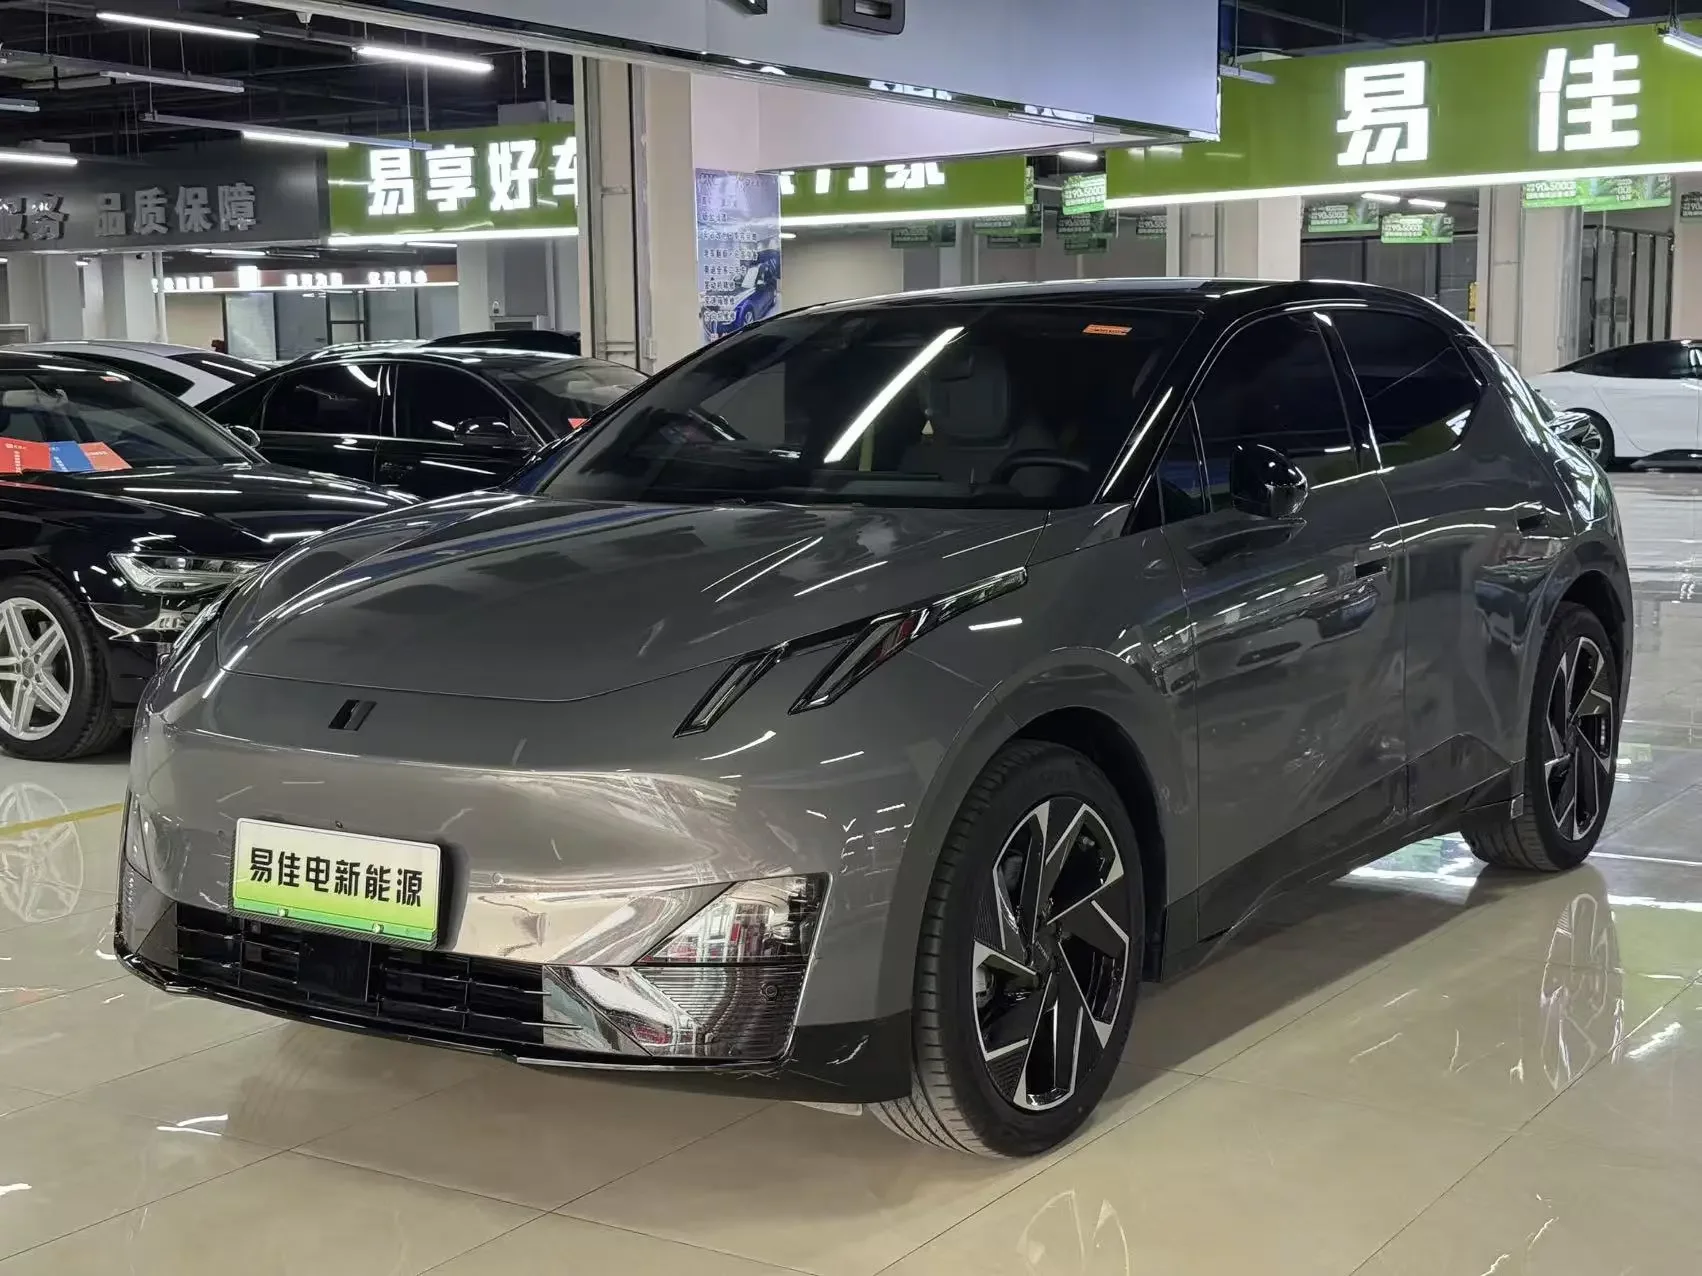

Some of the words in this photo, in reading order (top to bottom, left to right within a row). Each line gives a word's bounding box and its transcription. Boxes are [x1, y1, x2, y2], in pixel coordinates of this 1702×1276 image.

[1336, 43, 1641, 167] 易佳
[95, 182, 256, 237] 品质保障
[249, 846, 423, 907] 易佳电新能源
